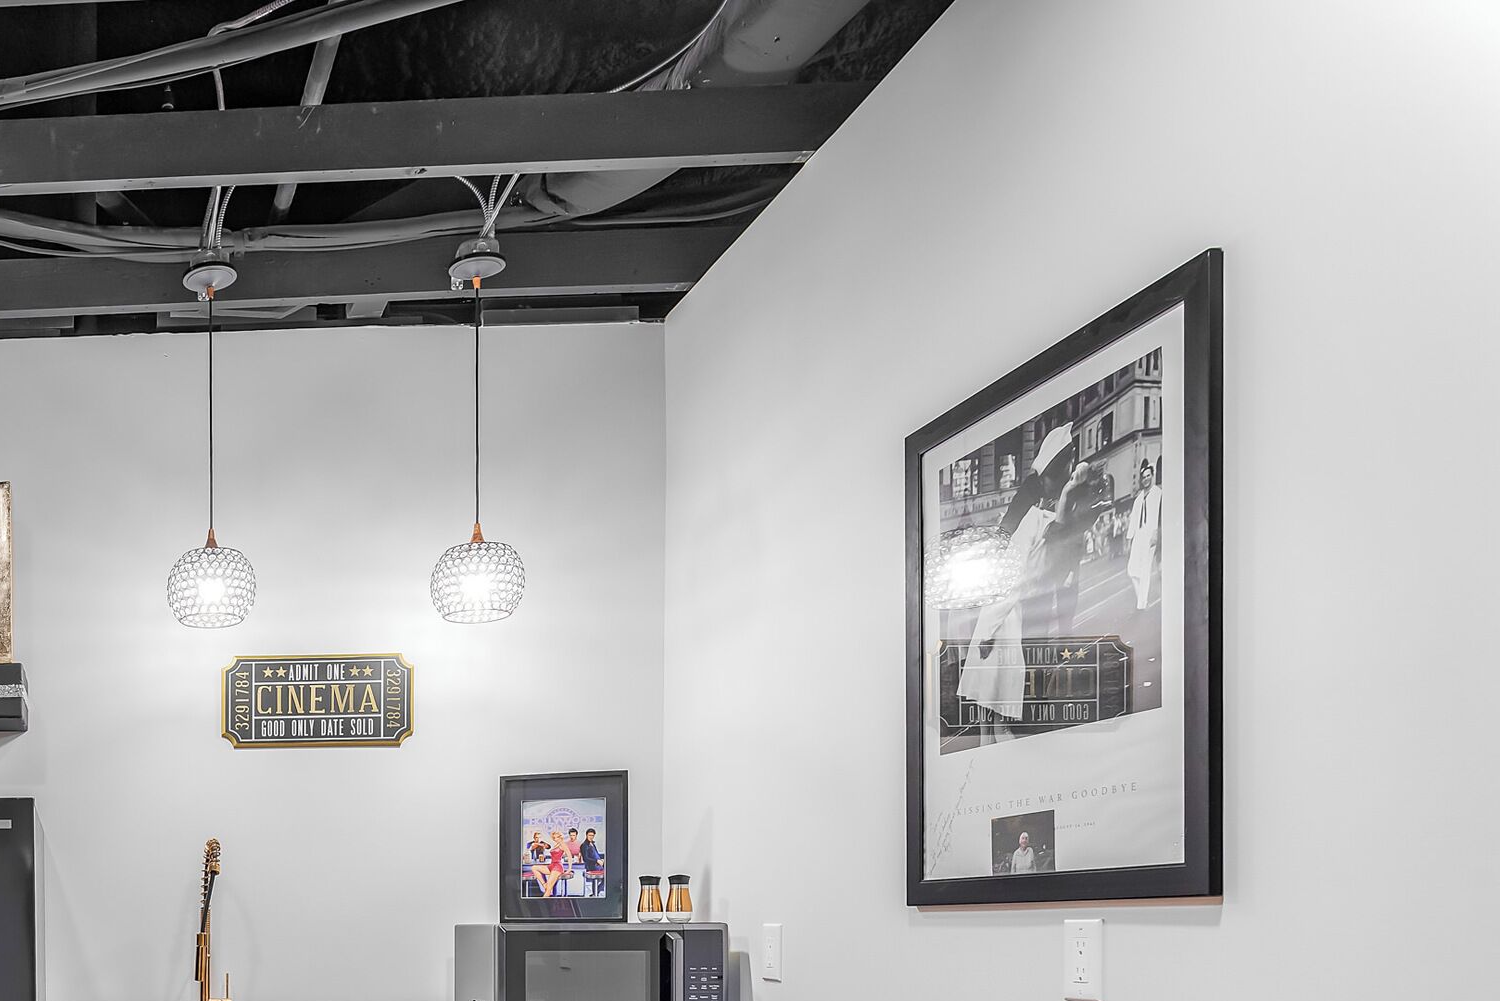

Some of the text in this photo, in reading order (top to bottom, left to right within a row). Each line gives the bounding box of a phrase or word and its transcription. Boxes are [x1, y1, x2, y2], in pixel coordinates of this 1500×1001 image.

[288, 663, 346, 681] ADMIT ONE
[234, 671, 250, 730] 3291784
[256, 683, 379, 715] CINEMA
[386, 669, 402, 729] 3291784
[261, 718, 374, 737] GOOD ONLY DATE SOLD
[956, 781, 1138, 816] KISSING THE WAR GOODBYE
